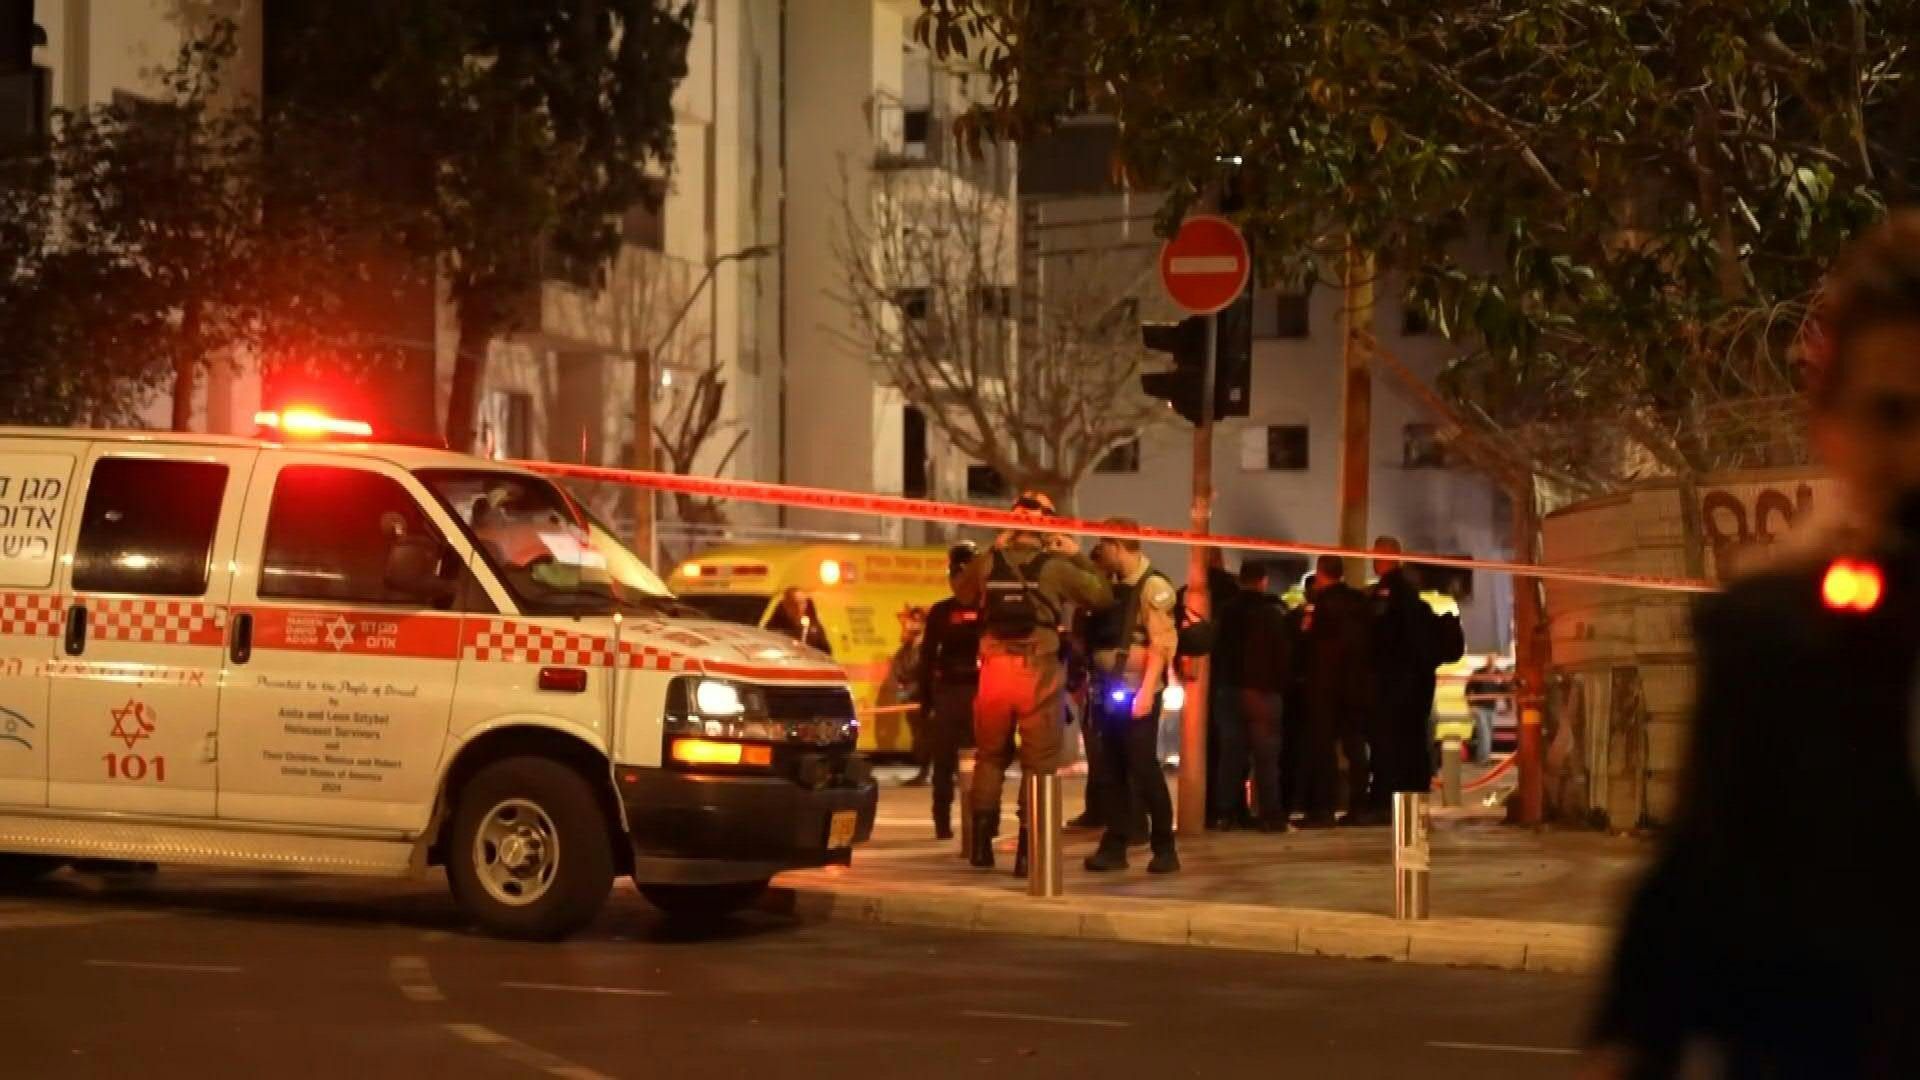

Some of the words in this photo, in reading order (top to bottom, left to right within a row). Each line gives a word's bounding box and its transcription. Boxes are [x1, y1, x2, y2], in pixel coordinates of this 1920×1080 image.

[20, 477, 62, 502] מגן
[307, 711, 324, 720] and
[102, 752, 165, 782] 101
